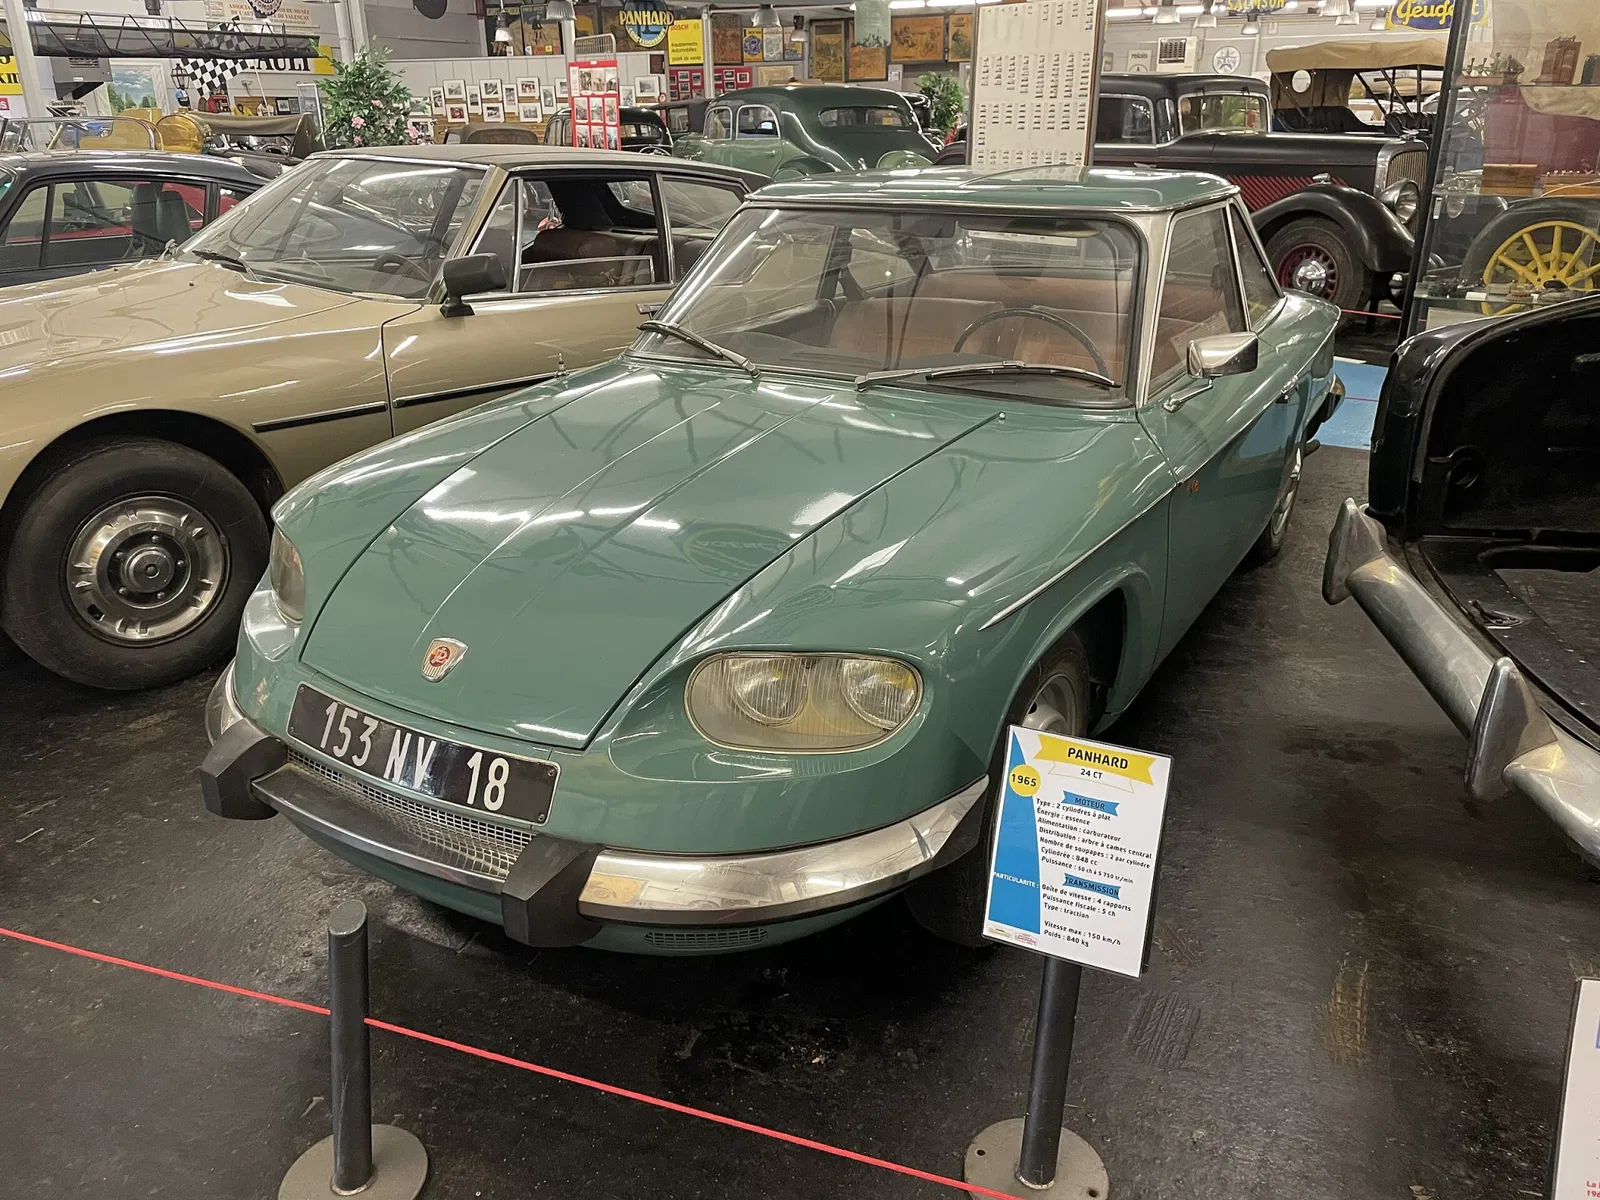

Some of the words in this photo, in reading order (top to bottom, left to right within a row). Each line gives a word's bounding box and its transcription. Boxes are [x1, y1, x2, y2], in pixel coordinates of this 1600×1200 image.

[619, 10, 674, 25] PANHARD
[320, 701, 379, 767] 153
[383, 729, 437, 790] NV
[467, 751, 510, 811] 18
[1068, 748, 1128, 769] PANHARD
[1012, 774, 1037, 786] 1965
[1081, 769, 1090, 777] 24
[1094, 771, 1103, 779] CT
[1037, 799, 1050, 807] Type
[1062, 805, 1091, 816] cylindres
[1075, 798, 1105, 810] MOTEUR
[1037, 807, 1060, 818] Énergie
[1065, 815, 1090, 825] essence
[1038, 817, 1077, 831] Alimentation
[1083, 829, 1121, 841] carburateur
[1039, 827, 1076, 840] Distribution
[1082, 838, 1099, 846] arbre
[1106, 844, 1126, 852] cames
[1129, 849, 1152, 859] central
[1040, 837, 1063, 847] Nombre
[1075, 845, 1104, 858] soupapes
[1126, 857, 1150, 868] cylindre
[1041, 846, 1070, 859] Cylindrée
[1076, 855, 1088, 863] 848
[1042, 856, 1072, 868] Puissance
[1115, 875, 1133, 884] tr/min
[1065, 878, 1119, 895] TRANSMISSION
[1042, 884, 1058, 893] Boîte
[1069, 890, 1091, 902] vitesse
[1103, 900, 1131, 911] rapports
[1043, 893, 1073, 906] Puissance
[1075, 902, 1096, 912] fiscale
[1044, 902, 1058, 911] Type
[1064, 908, 1089, 919] traction
[1044, 930, 1061, 939] Poids
[1045, 921, 1066, 931] Vitesse
[1069, 928, 1082, 936] max
[1102, 936, 1120, 945] km/h
[1586, 1180, 1596, 1188] La
